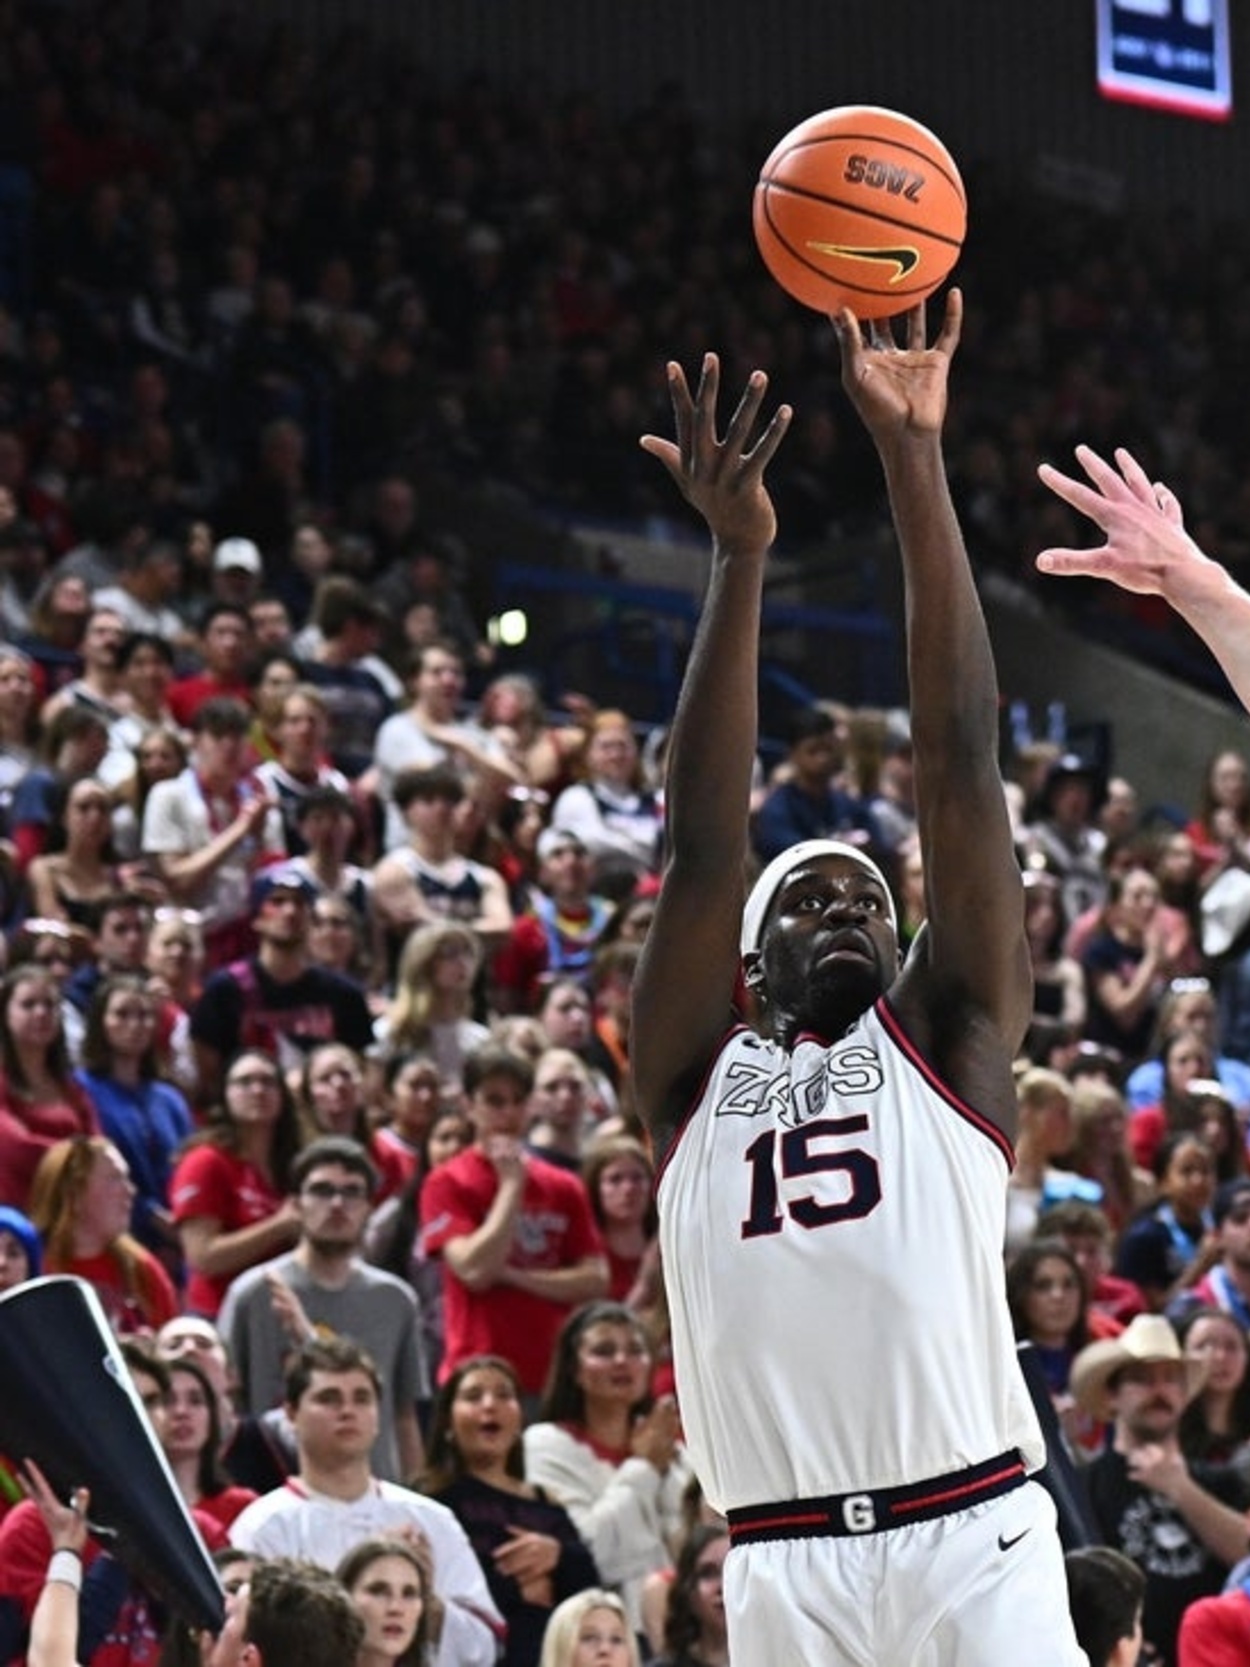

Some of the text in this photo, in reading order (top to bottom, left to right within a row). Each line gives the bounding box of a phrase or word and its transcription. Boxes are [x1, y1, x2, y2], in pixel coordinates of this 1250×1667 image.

[843, 154, 925, 204] ZAGS
[715, 1046, 884, 1129] ZAGS
[741, 1113, 882, 1240] 15
[842, 1493, 876, 1533] G
